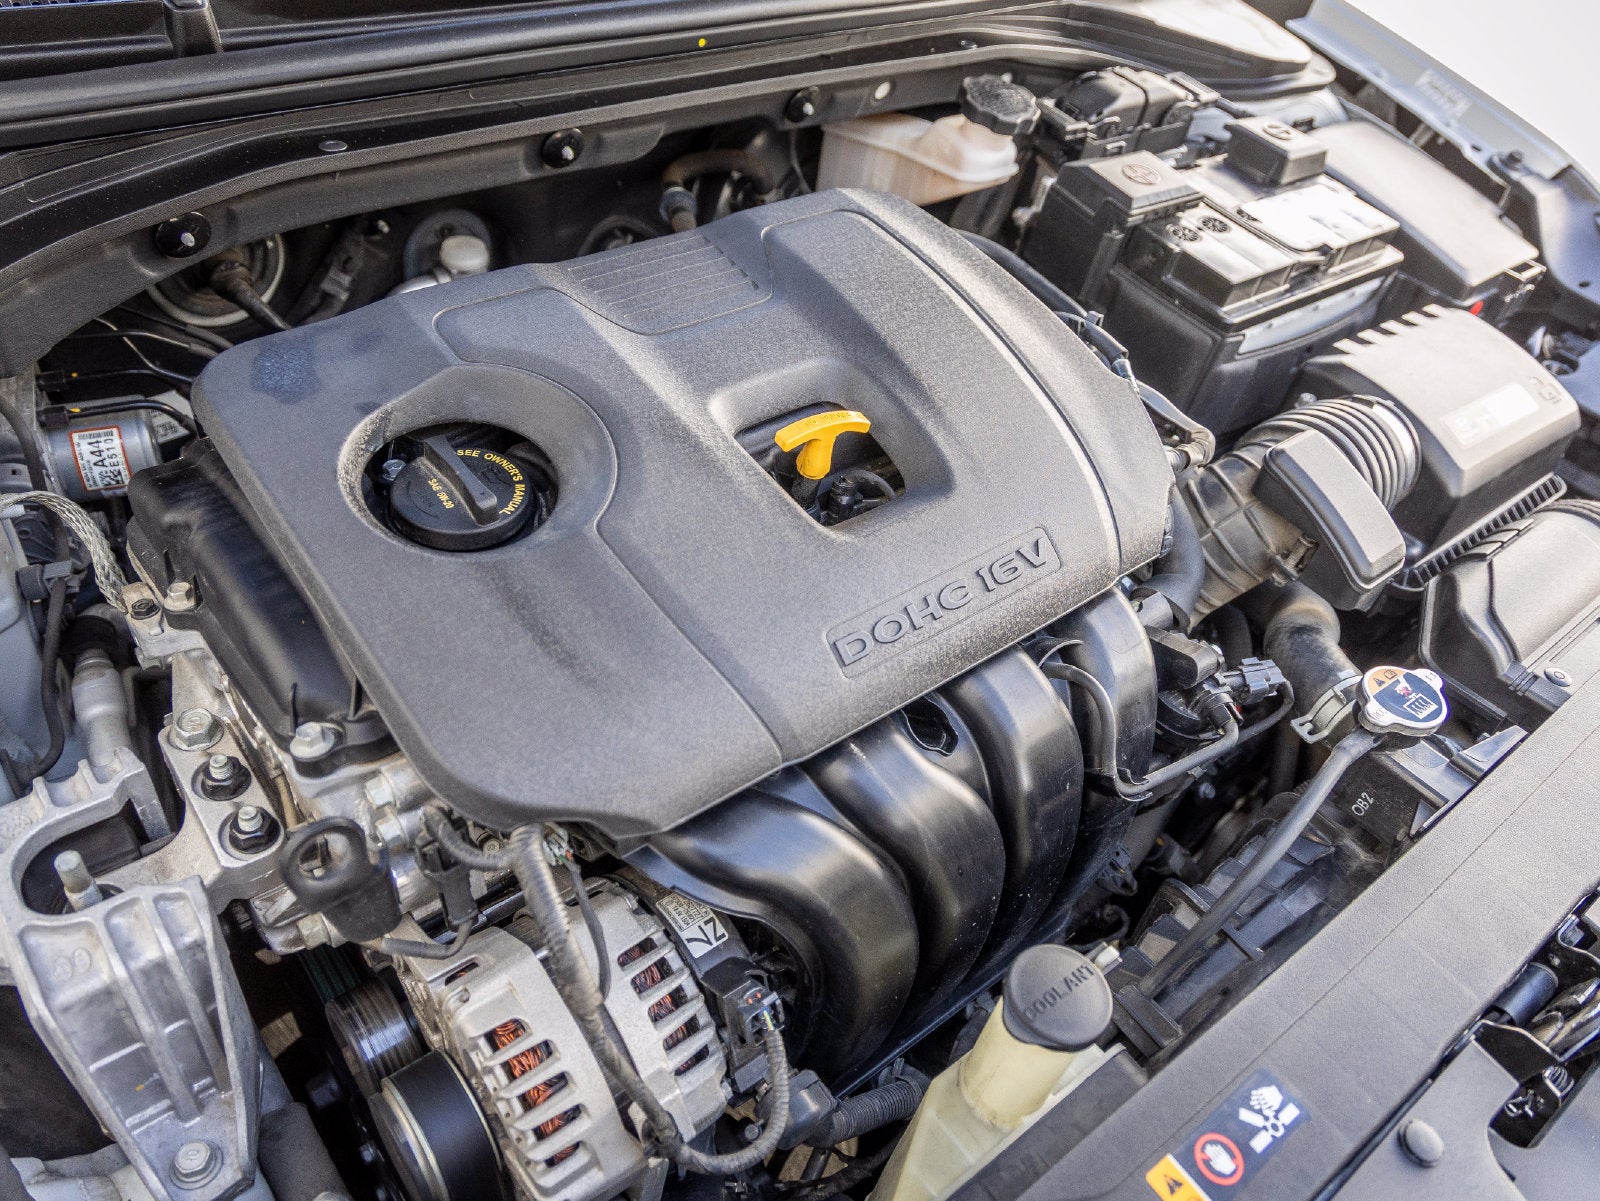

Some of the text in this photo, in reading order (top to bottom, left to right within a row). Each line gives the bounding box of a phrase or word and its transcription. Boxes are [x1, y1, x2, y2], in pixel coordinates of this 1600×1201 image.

[87, 439, 108, 468] A44
[104, 438, 120, 467] E510
[427, 478, 442, 492] SAE
[437, 491, 455, 510] 5W-20
[456, 449, 526, 515] SEE OWNER'S MANUAL
[834, 535, 1049, 666] DOHC 16V
[1351, 791, 1375, 816] OB2
[1024, 964, 1095, 1021] COOLANT
